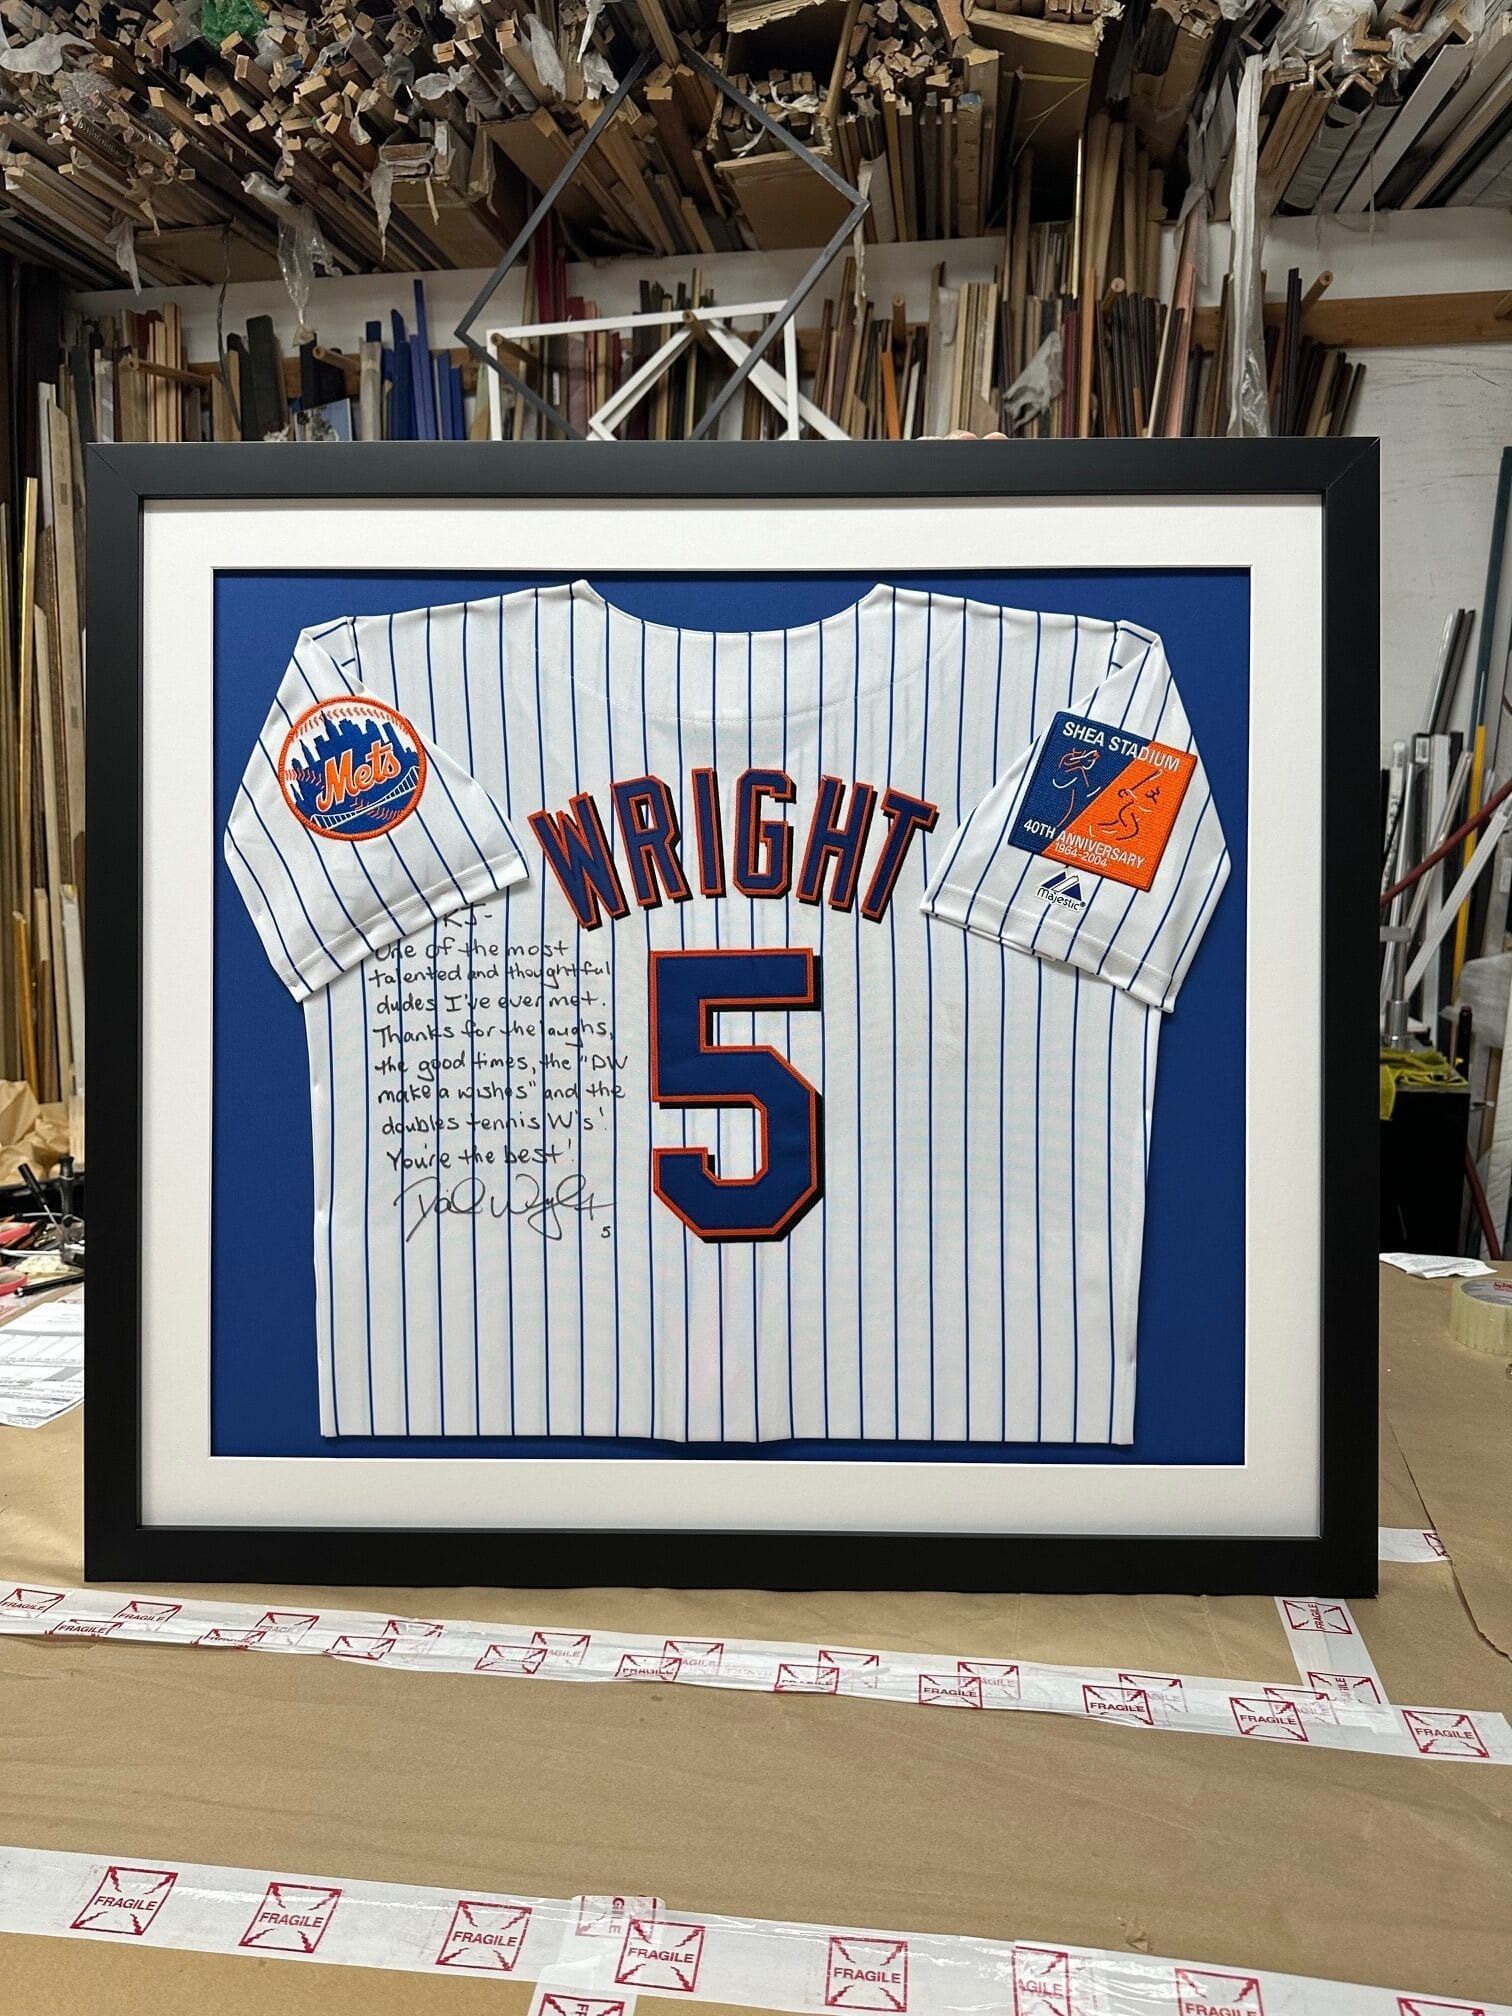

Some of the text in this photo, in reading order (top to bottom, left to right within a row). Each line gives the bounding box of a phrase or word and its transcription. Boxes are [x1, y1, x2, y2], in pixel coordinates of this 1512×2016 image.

[1062, 721, 1181, 772] SHEA STADIUM
[316, 740, 401, 812] Mets
[527, 767, 939, 931] WRIGHT
[1023, 818, 1145, 868] 40TH ANNIVERSARY
[1054, 842, 1108, 868] 1964-2004
[374, 937, 569, 961] One of the most
[368, 961, 611, 989] talented and thoughtful
[376, 994, 437, 1015] dudes
[444, 993, 498, 1013] I've
[499, 996, 541, 1008] ever
[373, 1024, 455, 1048] Thanks
[461, 1020, 496, 1038] for
[500, 1021, 536, 1037] the
[374, 1056, 408, 1076] the
[417, 1051, 465, 1082] good
[539, 1052, 572, 1070] the
[378, 1084, 431, 1103] make
[439, 1087, 450, 1099] a
[544, 1085, 578, 1099] and
[586, 1081, 626, 1099] the
[649, 947, 824, 1243] 5
[381, 1115, 459, 1135] doubles
[466, 1111, 541, 1131] tennis
[387, 1142, 451, 1171] You're
[458, 1147, 496, 1165] the
[1, 1601, 46, 1611] FRAGILE
[58, 1624, 109, 1634] FRAGILE
[923, 1687, 978, 1698] FRAGILE
[1089, 1702, 1146, 1713] FRAGILE
[1239, 1714, 1297, 1725] FRAGILE
[1414, 1726, 1476, 1740] FRAGILE
[94, 1894, 158, 1911] FRAGILE
[258, 1911, 324, 1929] FRAGILE
[608, 1897, 625, 1934] GILE
[452, 1930, 518, 1947] FRAGILE
[627, 1947, 695, 1964] FRAGILE
[833, 1966, 902, 1985] FRAGILE
[1017, 1978, 1064, 1999] AGILE
